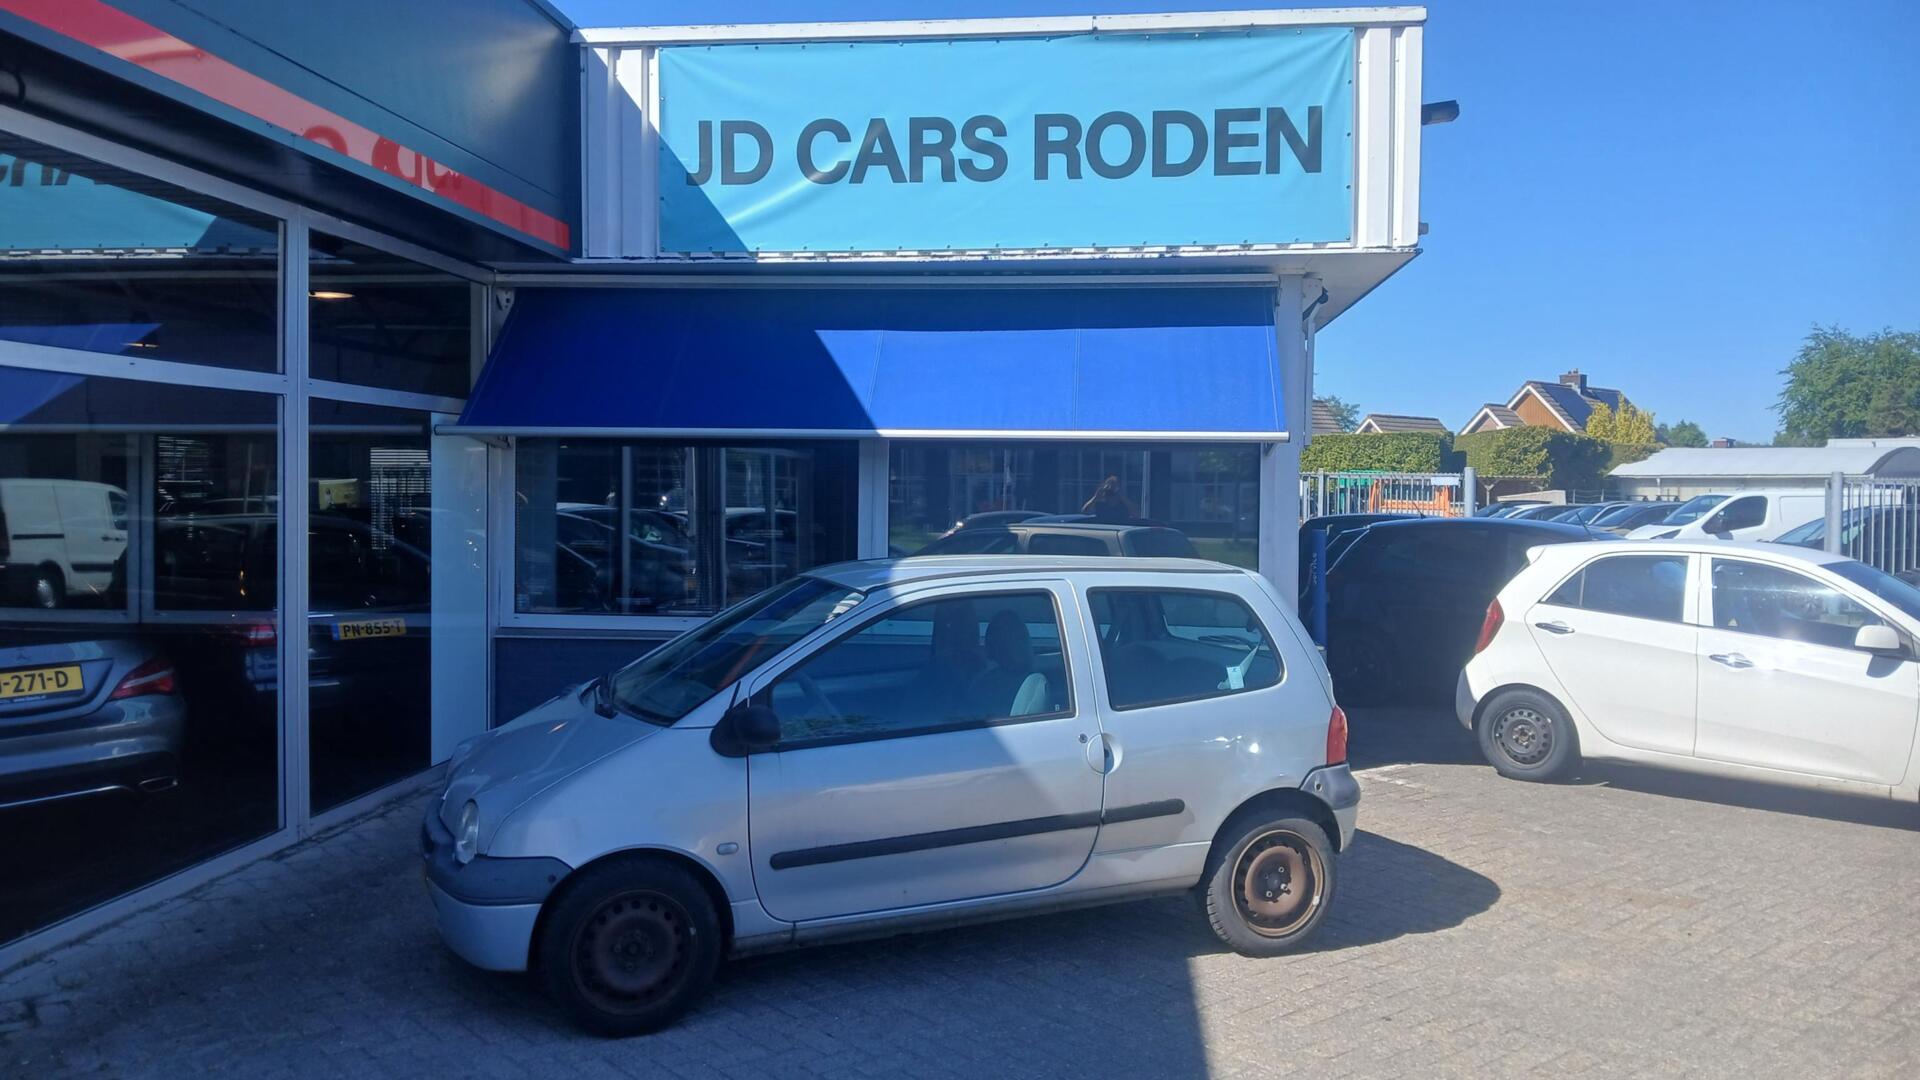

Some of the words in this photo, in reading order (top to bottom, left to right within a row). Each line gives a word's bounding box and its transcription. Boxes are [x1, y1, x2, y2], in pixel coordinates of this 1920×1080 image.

[686, 119, 774, 186] JD
[796, 114, 1009, 185] CARS
[1034, 105, 1323, 181] RODEN
[343, 620, 401, 638] PN-855-T
[0, 670, 69, 694] -271-D
